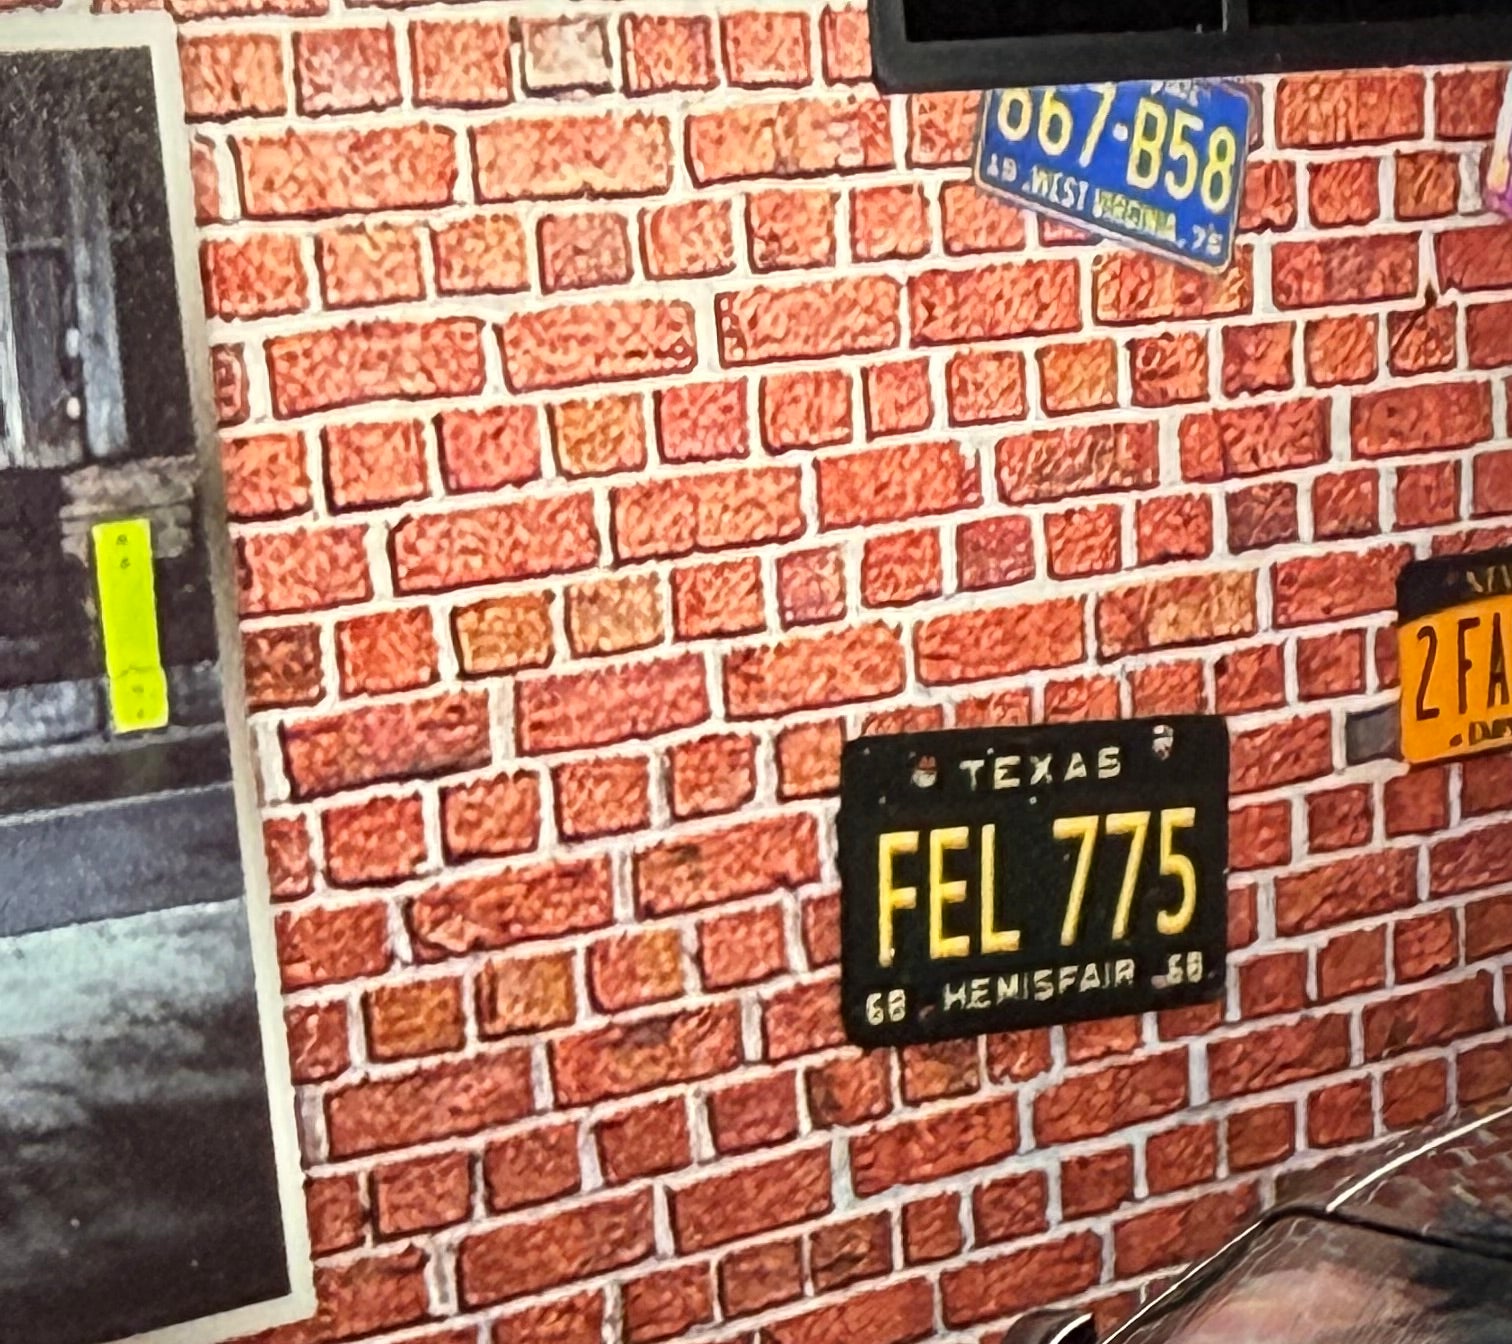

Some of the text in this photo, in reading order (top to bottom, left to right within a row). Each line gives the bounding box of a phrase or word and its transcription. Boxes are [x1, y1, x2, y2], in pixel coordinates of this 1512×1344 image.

[1416, 626, 1440, 721] 2
[959, 746, 1122, 791] TEXAS
[878, 807, 1197, 968] FEL 775
[943, 958, 1136, 1012] HEMISFAIR
